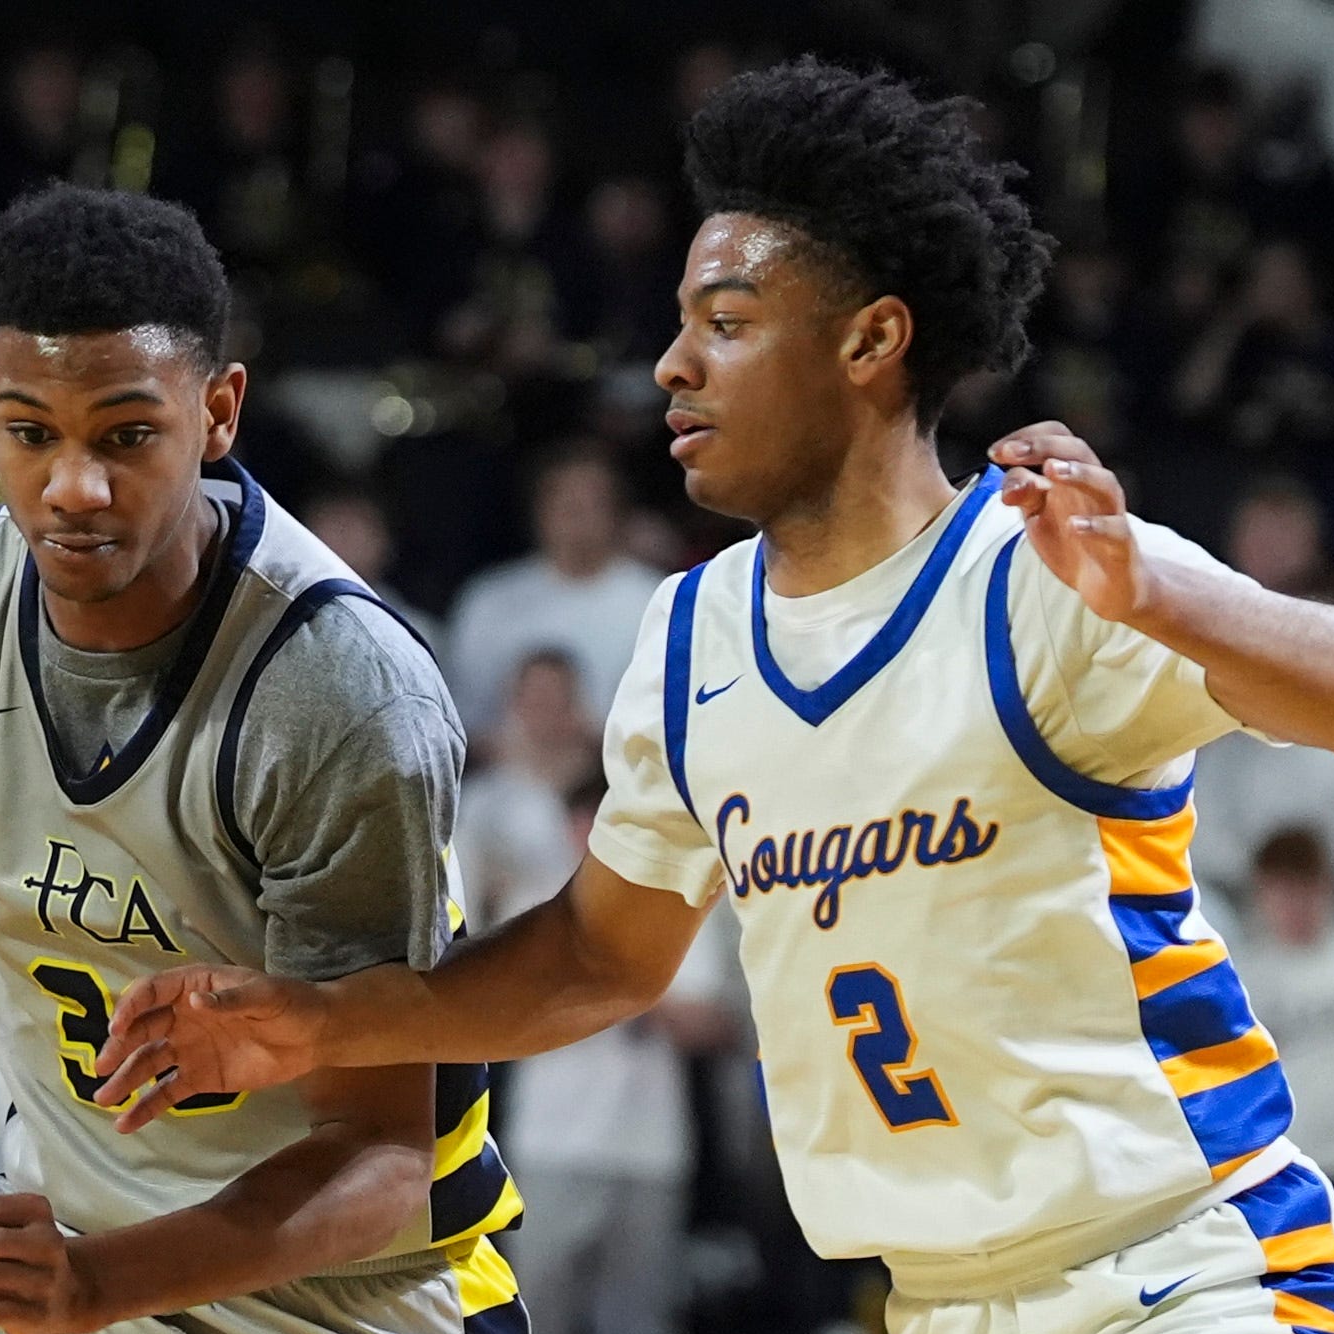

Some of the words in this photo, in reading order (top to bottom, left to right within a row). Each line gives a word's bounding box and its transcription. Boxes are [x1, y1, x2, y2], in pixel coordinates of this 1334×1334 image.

[21, 836, 186, 956] PCA
[716, 792, 999, 931] Cougars
[27, 956, 250, 1116] 3
[825, 962, 961, 1133] 2
